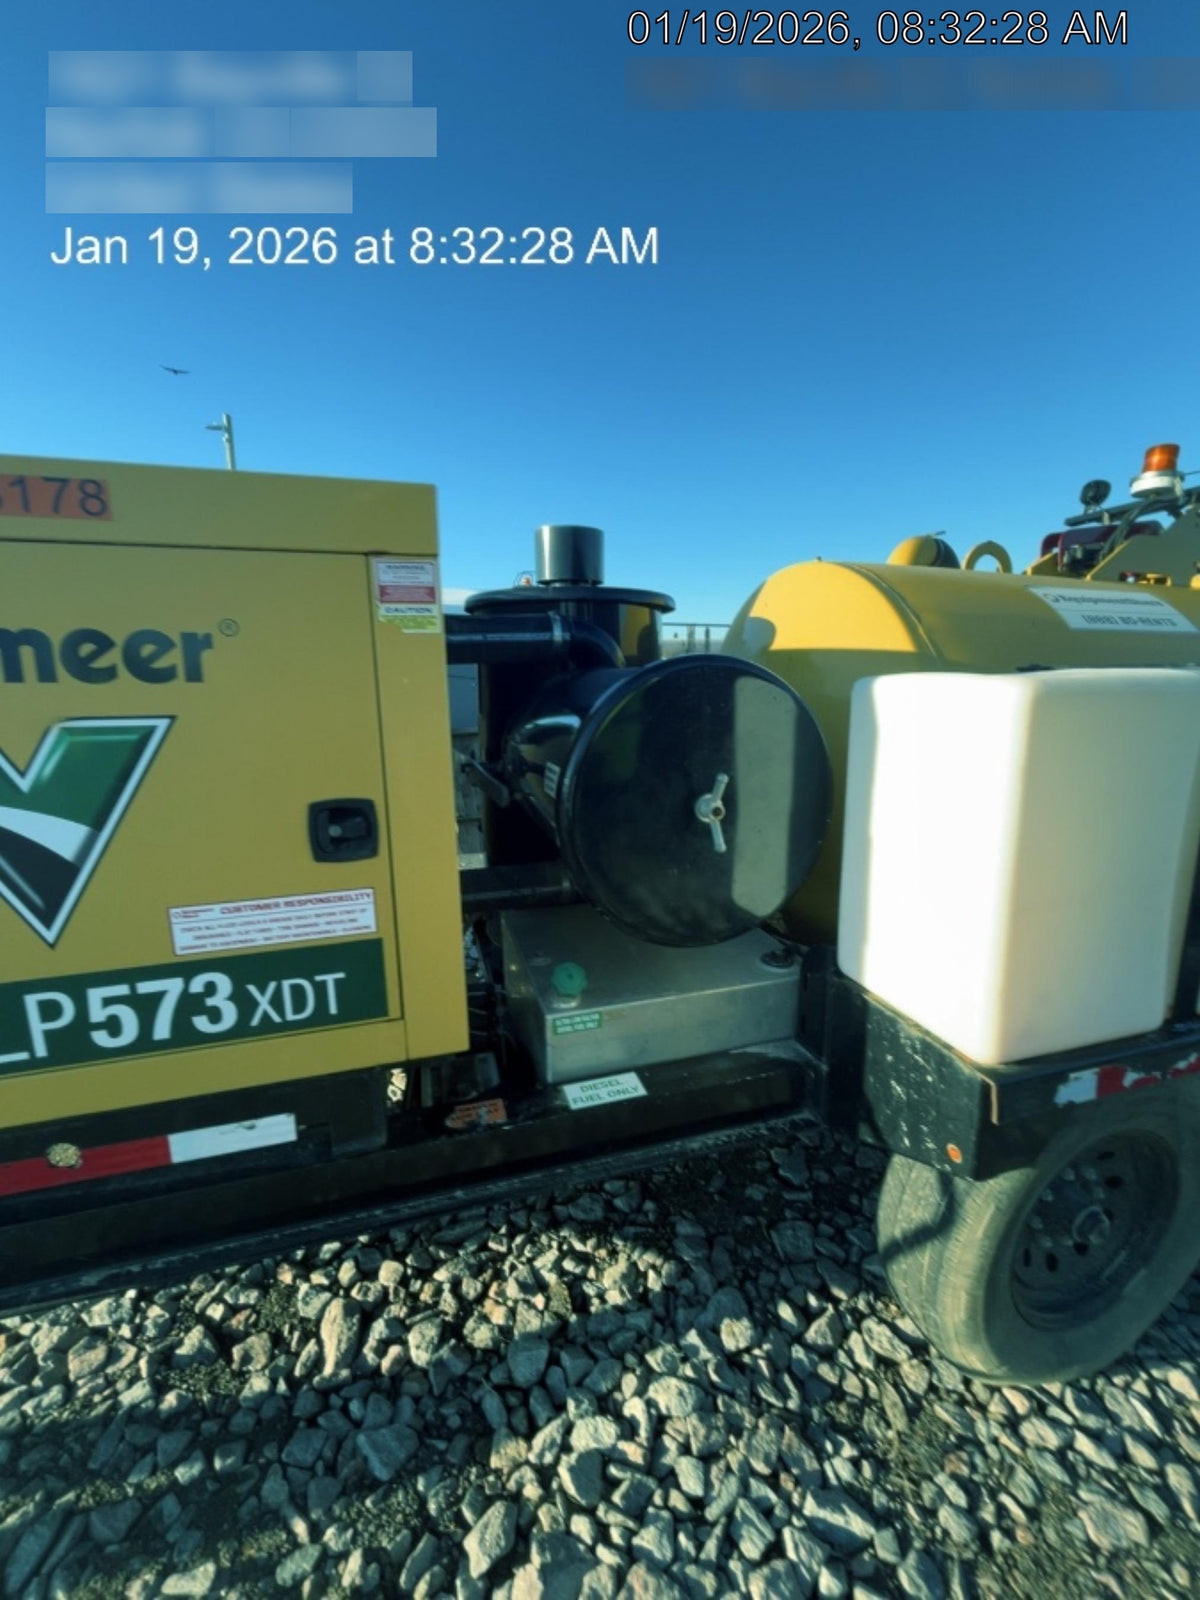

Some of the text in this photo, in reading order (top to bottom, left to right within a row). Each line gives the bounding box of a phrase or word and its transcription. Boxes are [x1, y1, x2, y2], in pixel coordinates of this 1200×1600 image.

[0, 476, 107, 516] 178
[220, 902, 281, 914] CUSTOMER
[283, 893, 371, 908] RESPONSIBILITY
[246, 972, 347, 1027] XDT
[571, 1085, 640, 1105] FUEL ONLY
[580, 1080, 621, 1093] DIESEL
